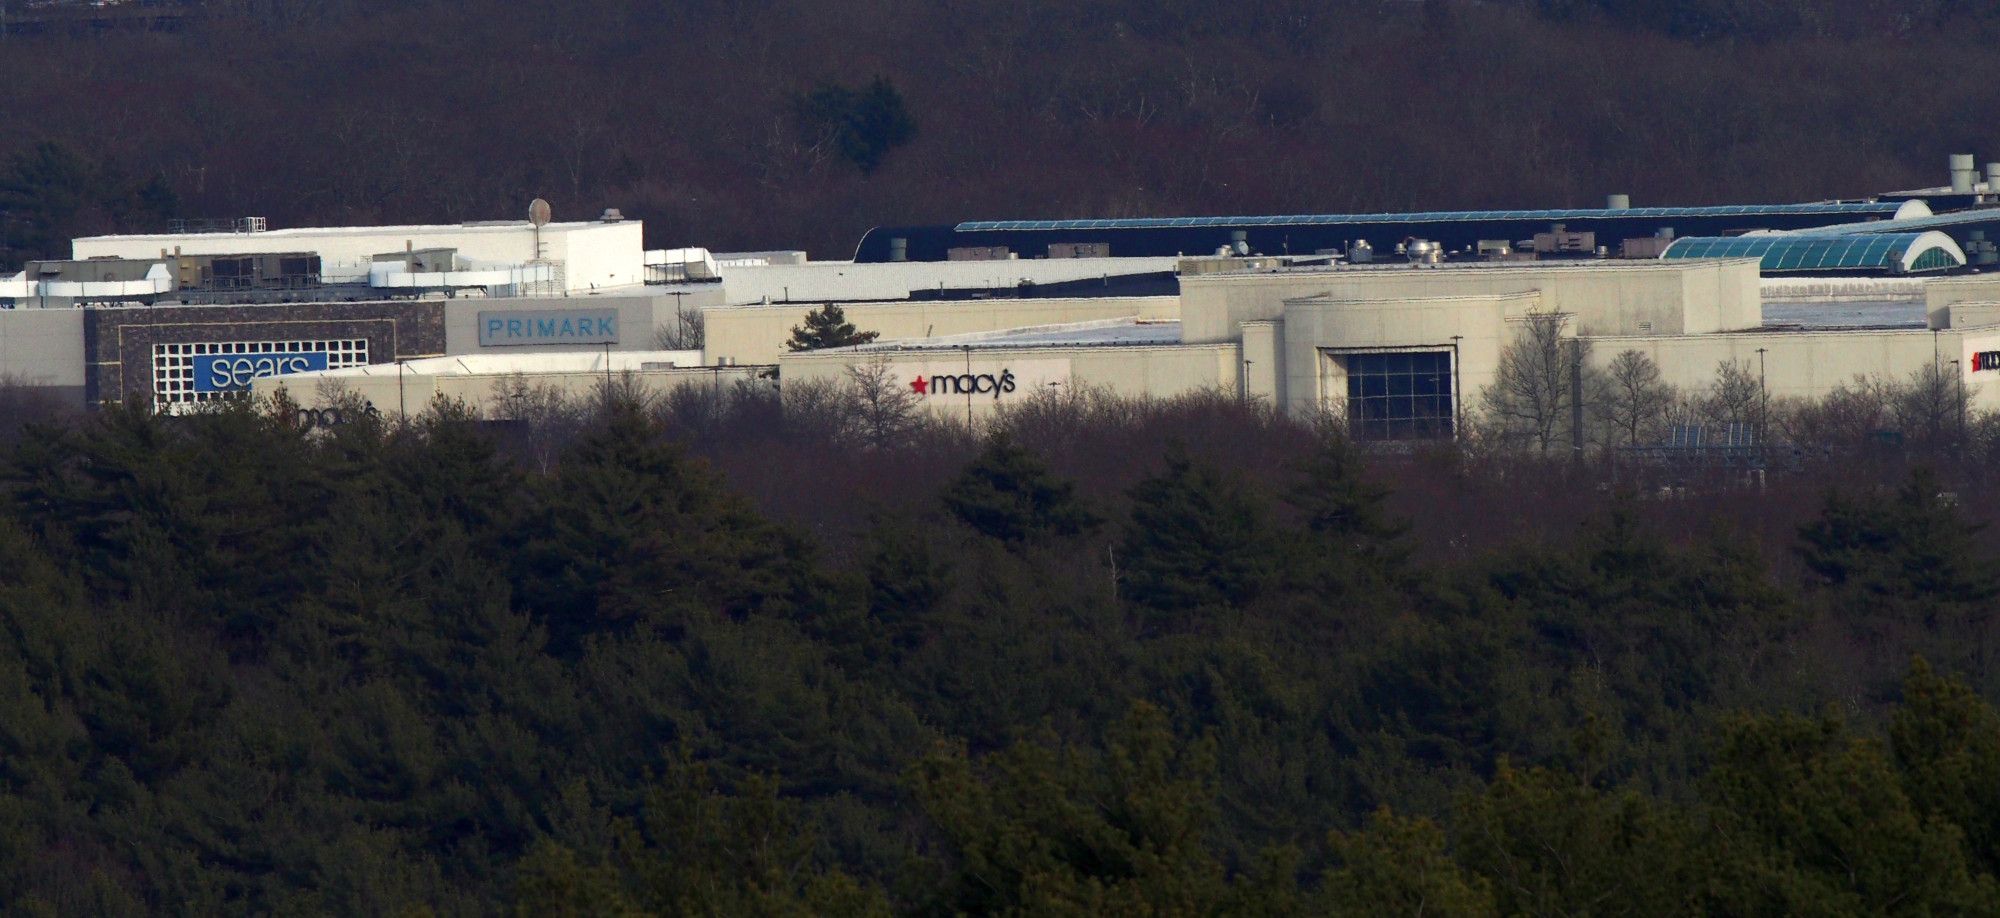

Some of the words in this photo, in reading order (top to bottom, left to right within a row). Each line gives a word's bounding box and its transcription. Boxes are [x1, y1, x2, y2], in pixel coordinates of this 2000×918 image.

[487, 316, 614, 338] PRIMARK
[211, 357, 309, 387] sears
[931, 368, 1016, 399] macy's
